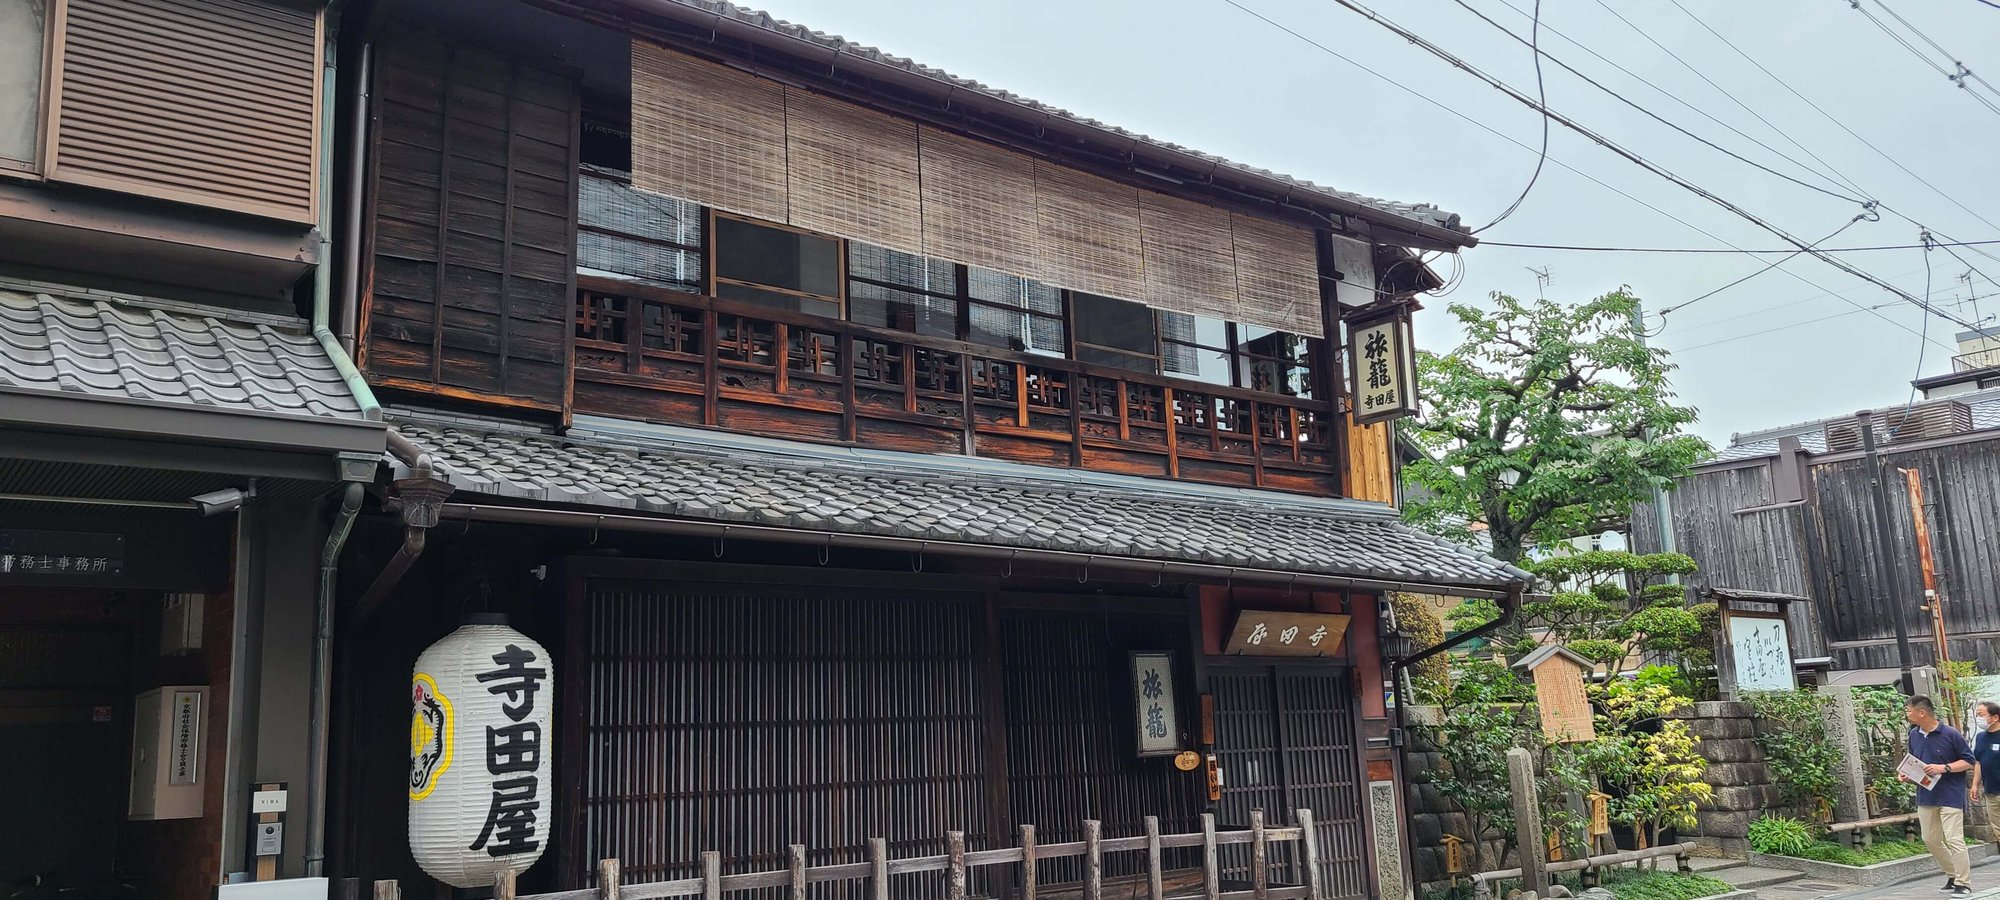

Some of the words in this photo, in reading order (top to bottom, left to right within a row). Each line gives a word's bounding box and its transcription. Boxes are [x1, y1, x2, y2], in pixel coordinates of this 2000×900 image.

[1364, 330, 1392, 389] 旅籠
[1364, 389, 1396, 409] 寺田屋
[1142, 668, 1168, 739] 旅籠
[468, 643, 547, 858] 寺田屋
